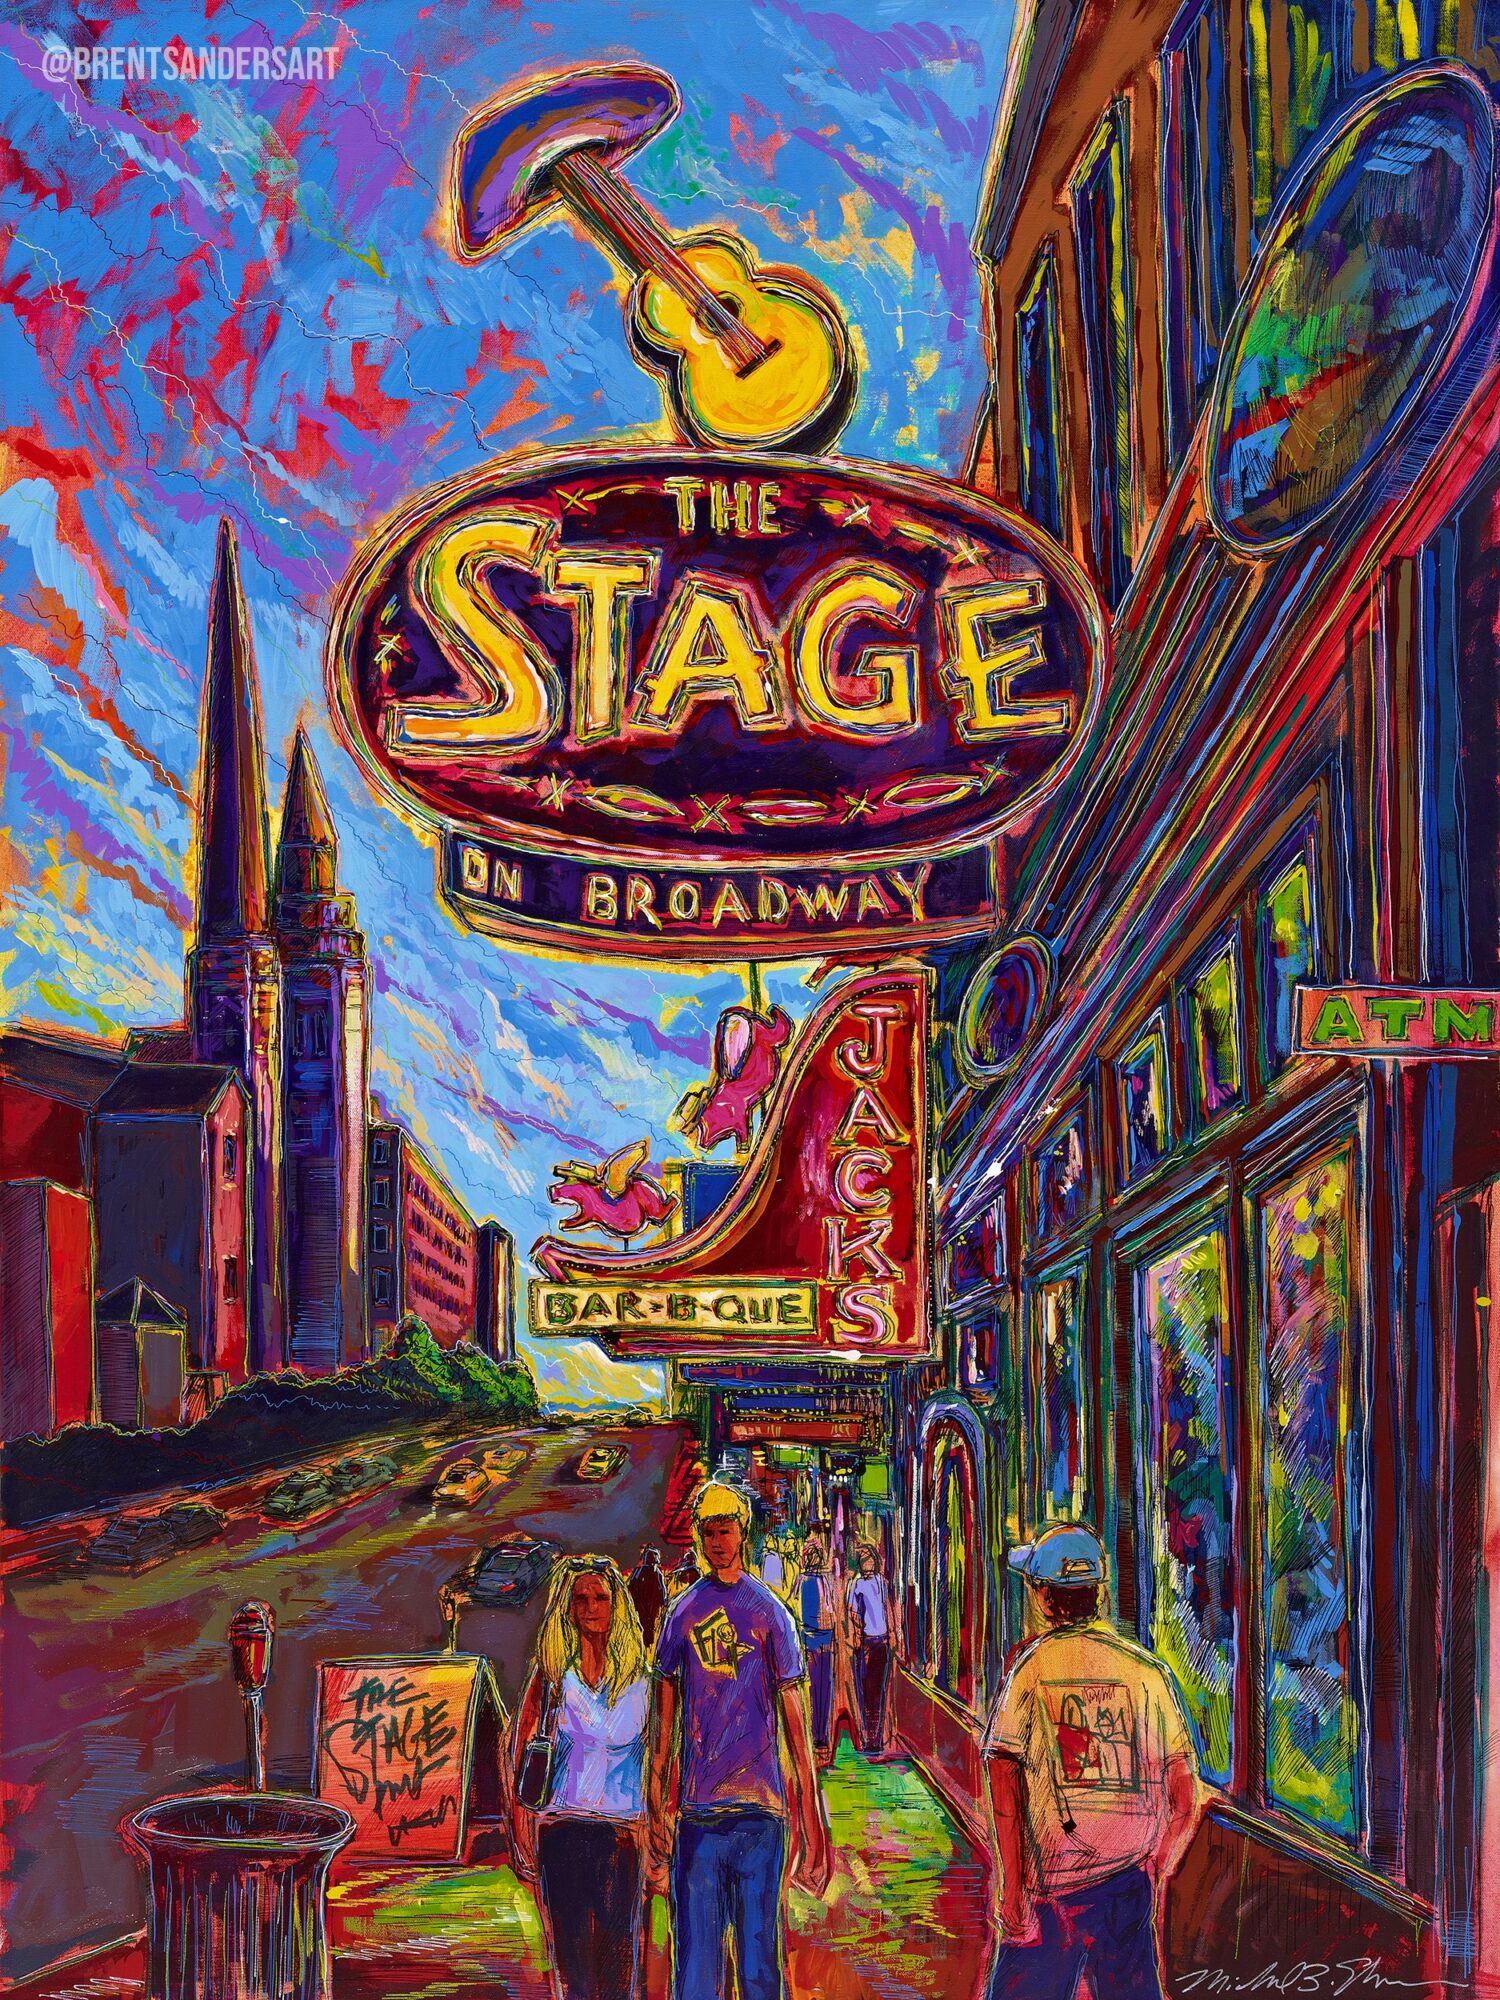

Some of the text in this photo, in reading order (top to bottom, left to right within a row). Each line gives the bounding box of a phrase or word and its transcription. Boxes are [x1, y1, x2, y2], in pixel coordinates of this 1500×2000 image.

[664, 475, 783, 535] THE
[386, 506, 1071, 757] STAGE
[461, 847, 930, 925] ON BROADWAY
[1306, 994, 1496, 1045] ATM
[826, 1003, 906, 1344] JACKS
